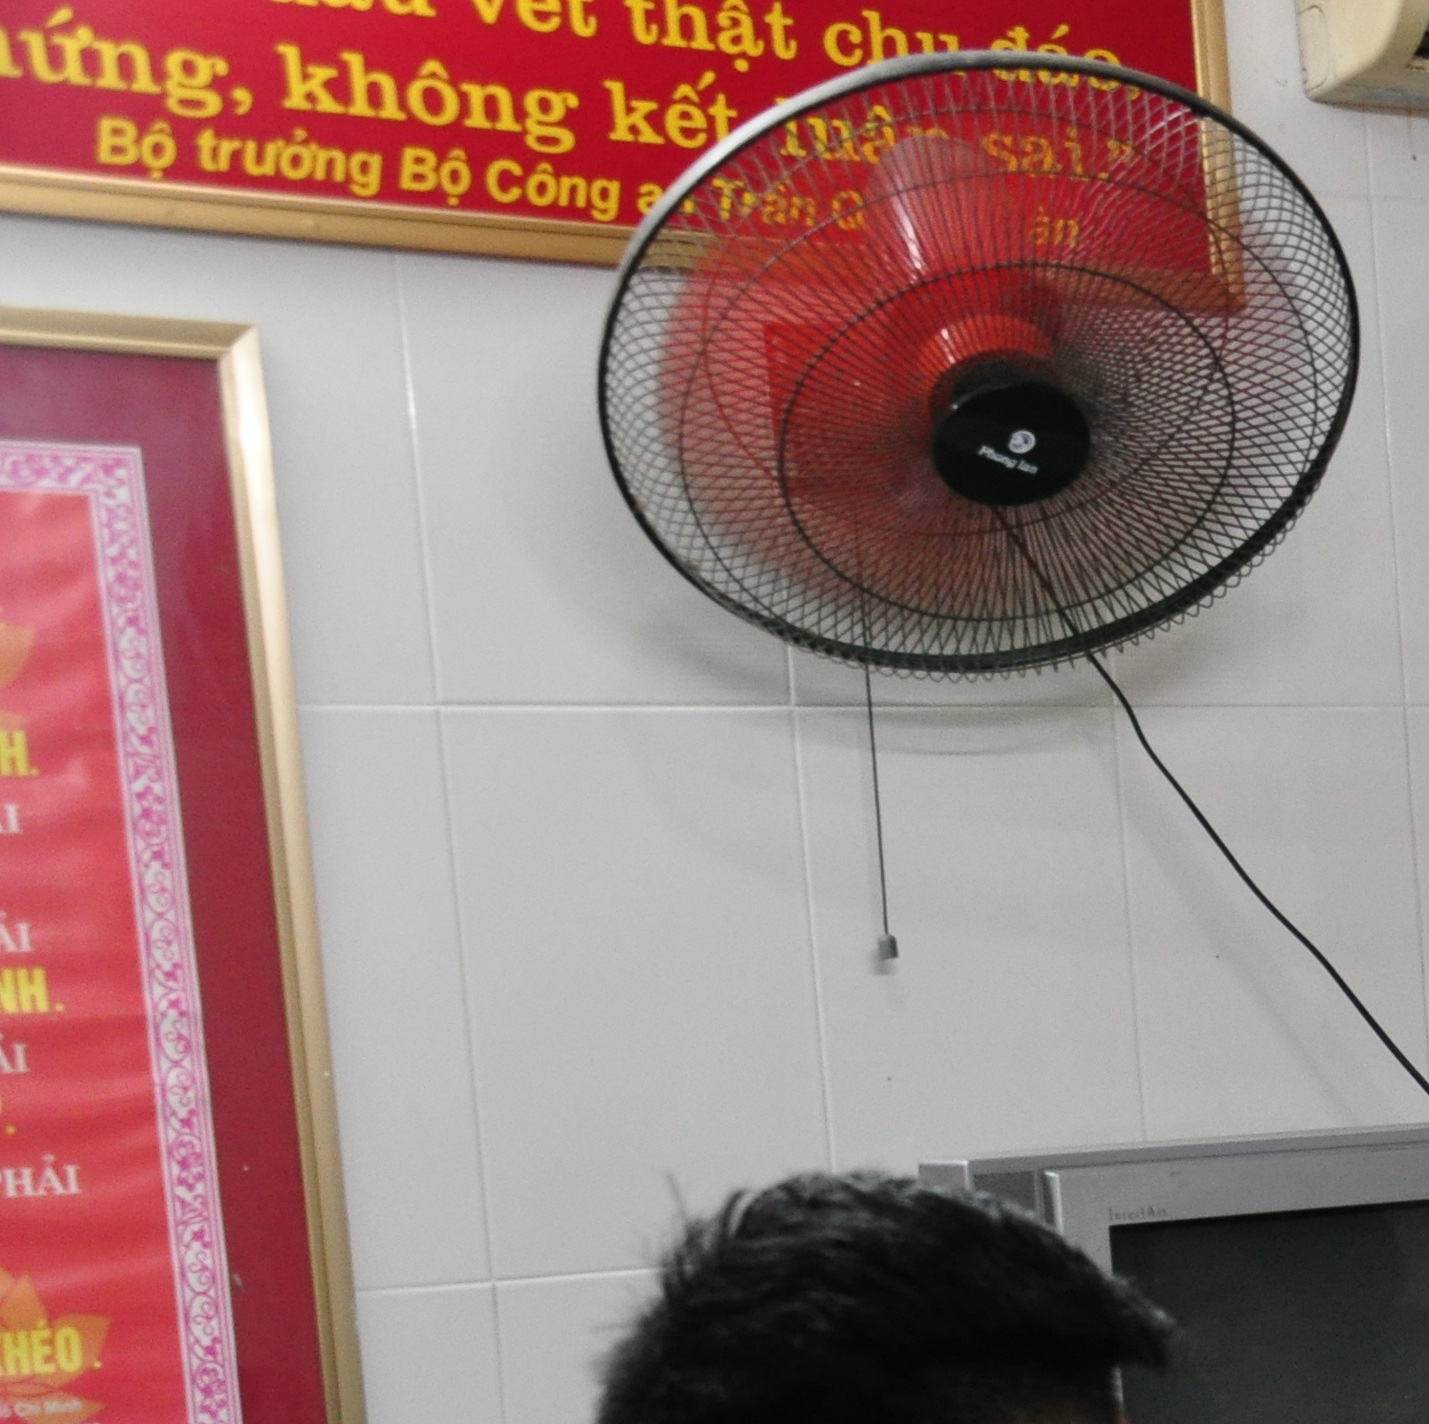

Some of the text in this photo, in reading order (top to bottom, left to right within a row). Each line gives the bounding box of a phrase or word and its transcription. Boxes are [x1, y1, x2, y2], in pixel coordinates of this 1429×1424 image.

[624, 0, 797, 72] thật
[276, 43, 580, 154] không
[603, 71, 738, 149] kết
[96, 117, 177, 181] Bộ
[196, 127, 383, 197] trưởng
[399, 147, 472, 205] Bộ
[485, 160, 621, 222] Công
